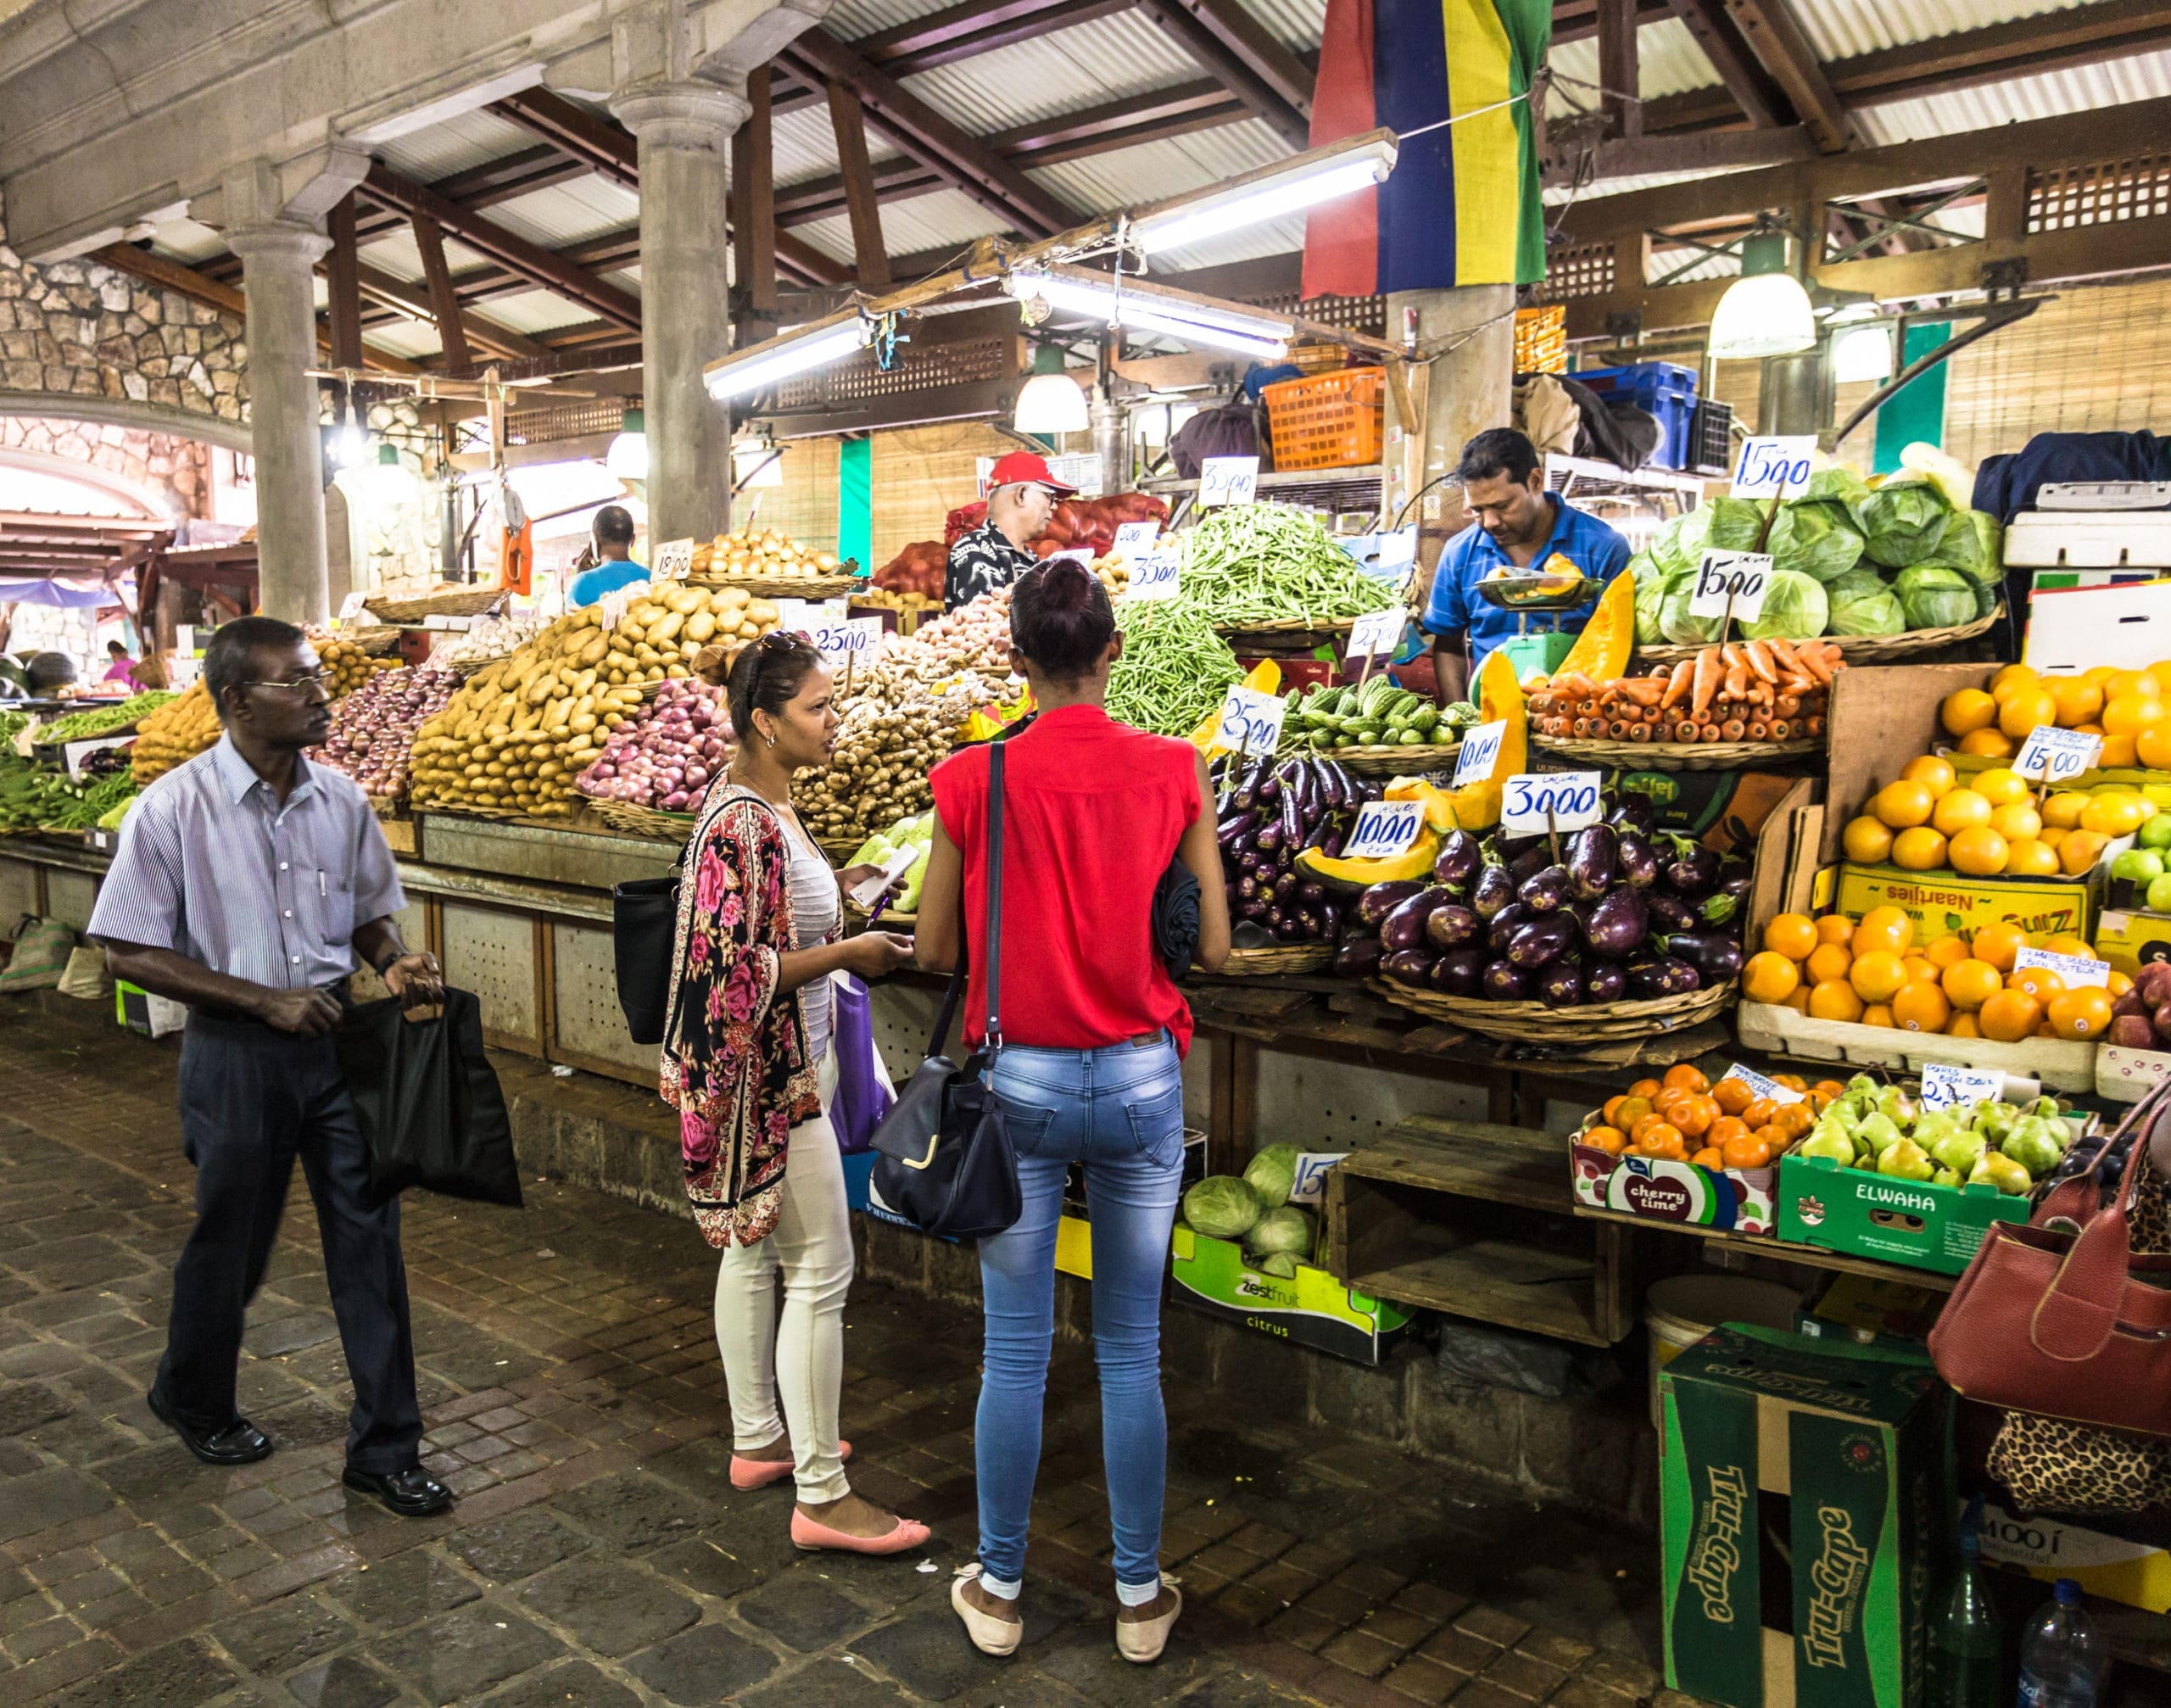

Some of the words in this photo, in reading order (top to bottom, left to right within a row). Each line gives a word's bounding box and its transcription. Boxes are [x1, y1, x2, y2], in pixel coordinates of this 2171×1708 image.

[1737, 442, 1810, 486] 1500
[1132, 555, 1177, 586] 3500
[1696, 556, 1763, 598] 1500
[817, 628, 866, 651] 2500
[1223, 697, 1275, 749] 2500
[1456, 736, 1498, 775] 1000
[1507, 781, 1596, 816] 3000
[1350, 812, 1416, 848] 1000
[1887, 885, 1973, 911] Naartjies
[1939, 1074, 1962, 1084] BIEN
[1630, 1185, 1685, 1204] cherry
[1641, 1197, 1678, 1211] time
[1856, 1184, 1936, 1212] ELWAHA
[1242, 1281, 1300, 1308] zestfruit
[1247, 1316, 1289, 1337] citrus
[1688, 1465, 1749, 1624] Tru-Cape
[1803, 1506, 1868, 1669] Tru-Cape
